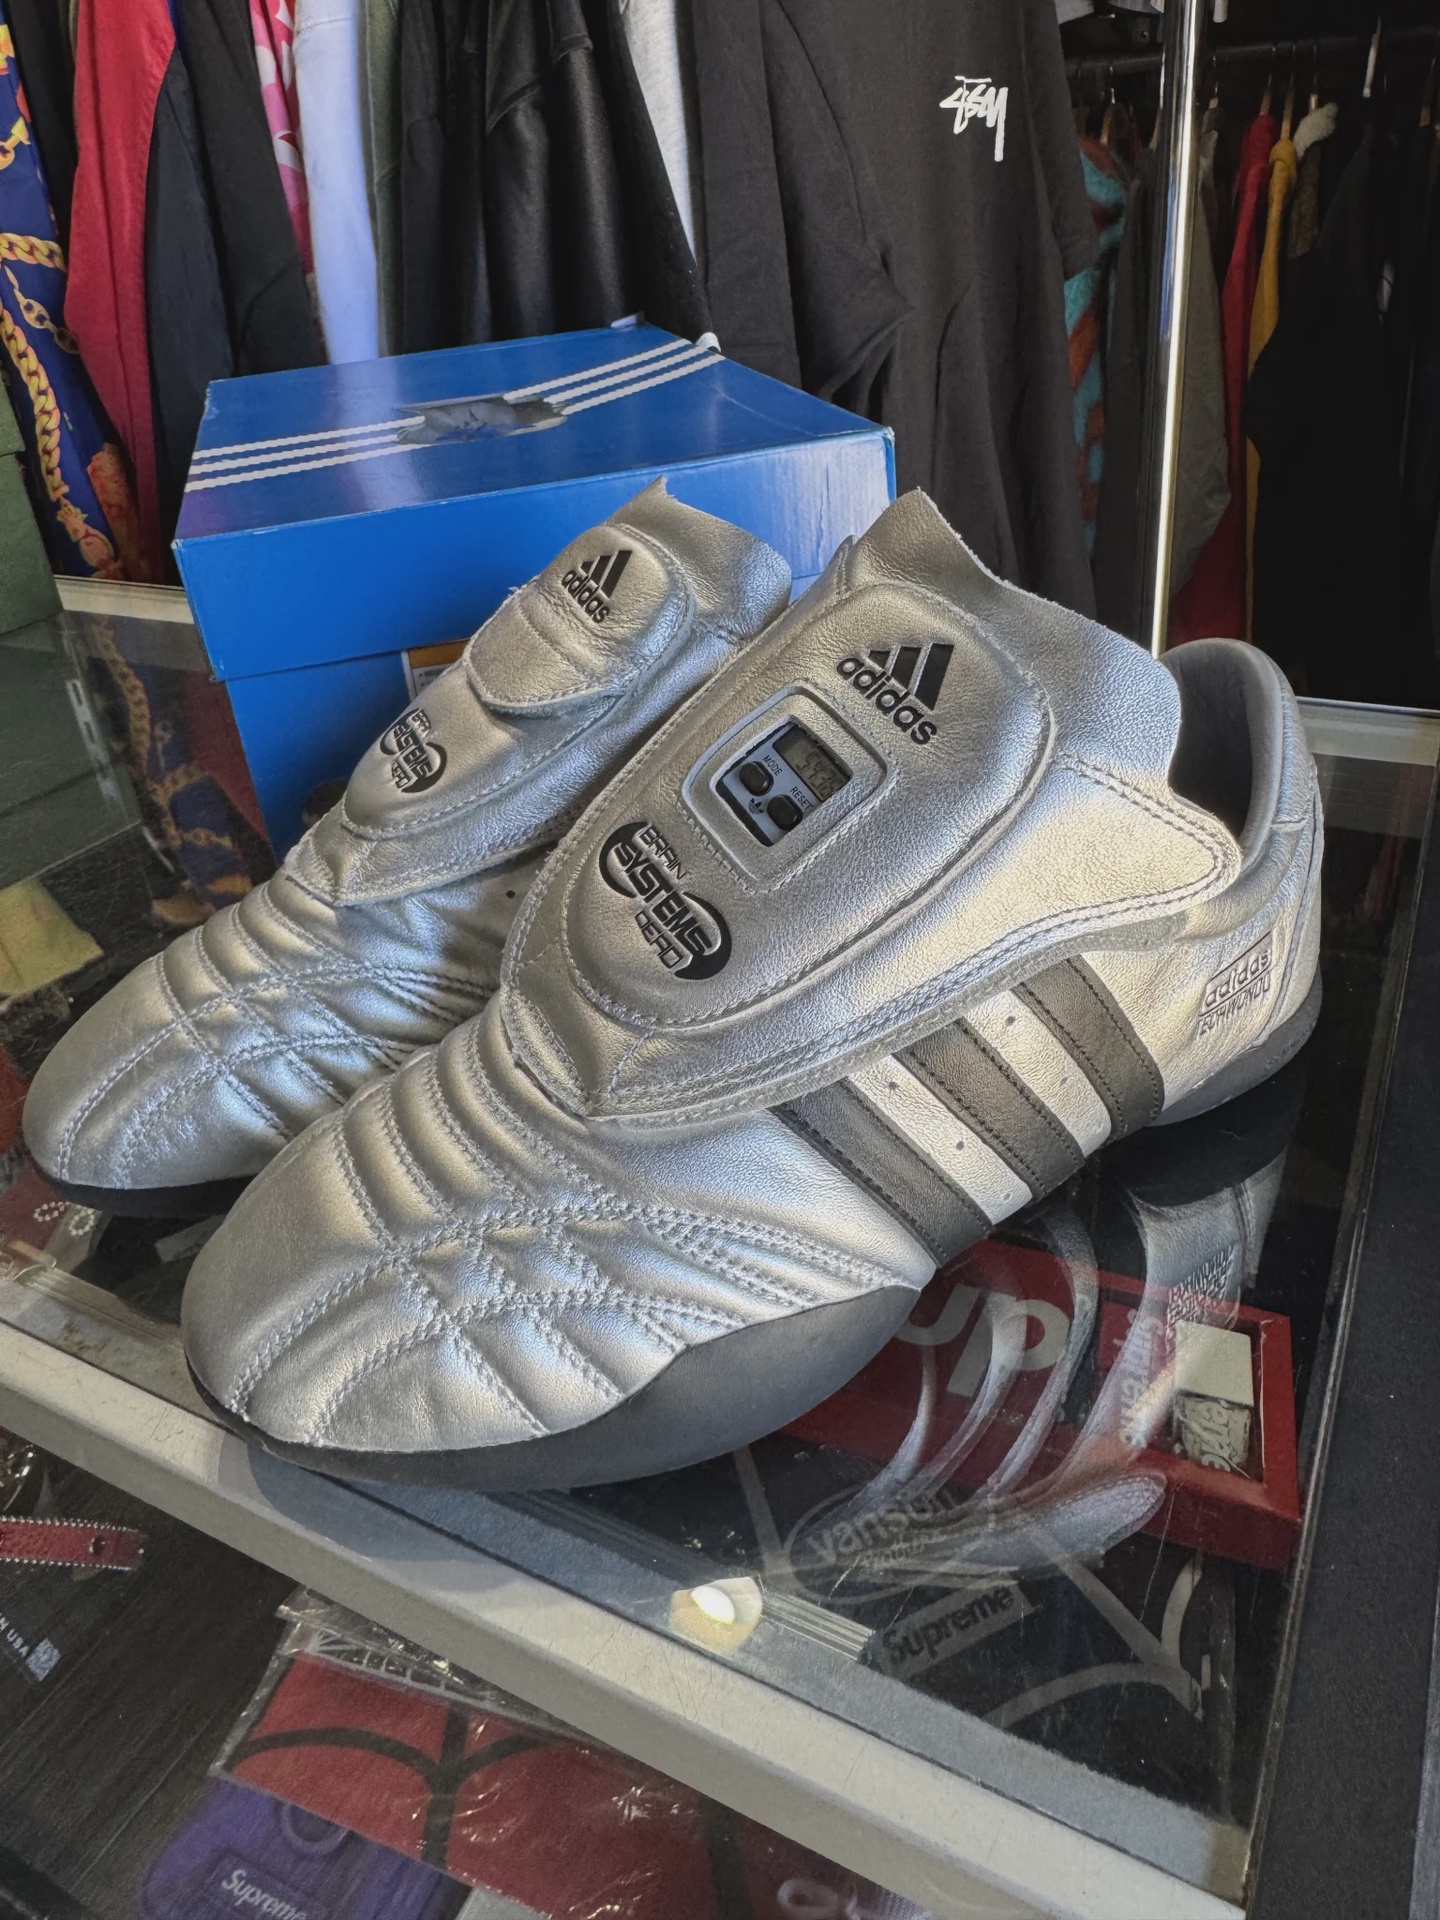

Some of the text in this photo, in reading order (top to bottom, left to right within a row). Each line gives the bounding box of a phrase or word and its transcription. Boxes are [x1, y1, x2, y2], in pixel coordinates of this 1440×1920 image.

[561, 569, 610, 623] adidas
[837, 657, 938, 745] adidas
[763, 754, 783, 777] MODE
[789, 785, 814, 811] RESET
[638, 825, 689, 880] BRAIN
[613, 843, 713, 955] SYSTEMS
[634, 910, 684, 969] DEAD
[1204, 952, 1270, 1008] adidas
[882, 1585, 1016, 1666] Supreme
